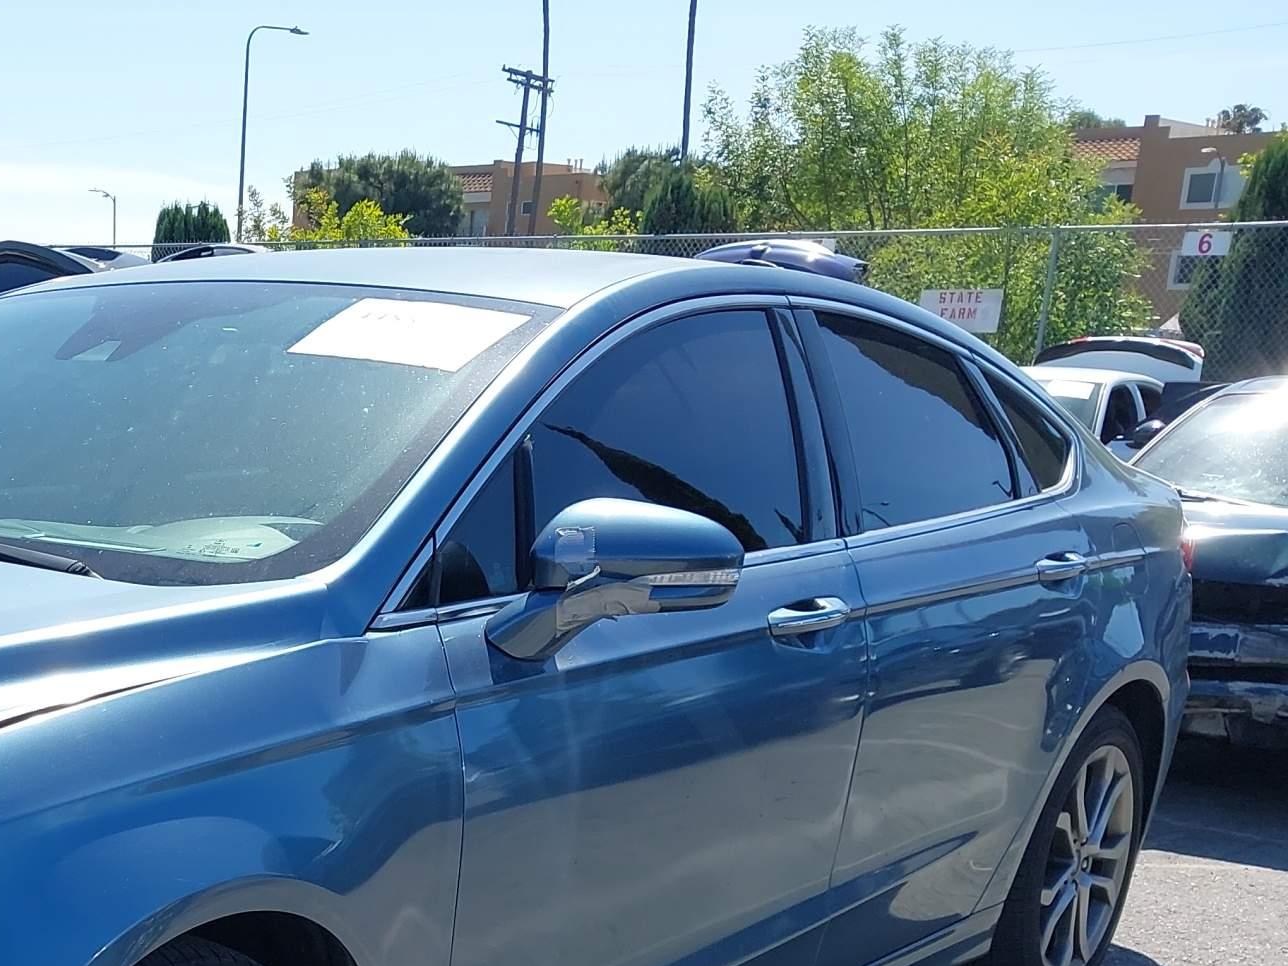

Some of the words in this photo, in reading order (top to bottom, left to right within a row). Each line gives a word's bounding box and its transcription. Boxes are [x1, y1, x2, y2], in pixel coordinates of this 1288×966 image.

[1198, 233, 1213, 254] 6
[938, 291, 984, 304] STATE
[939, 307, 978, 320] FARM
